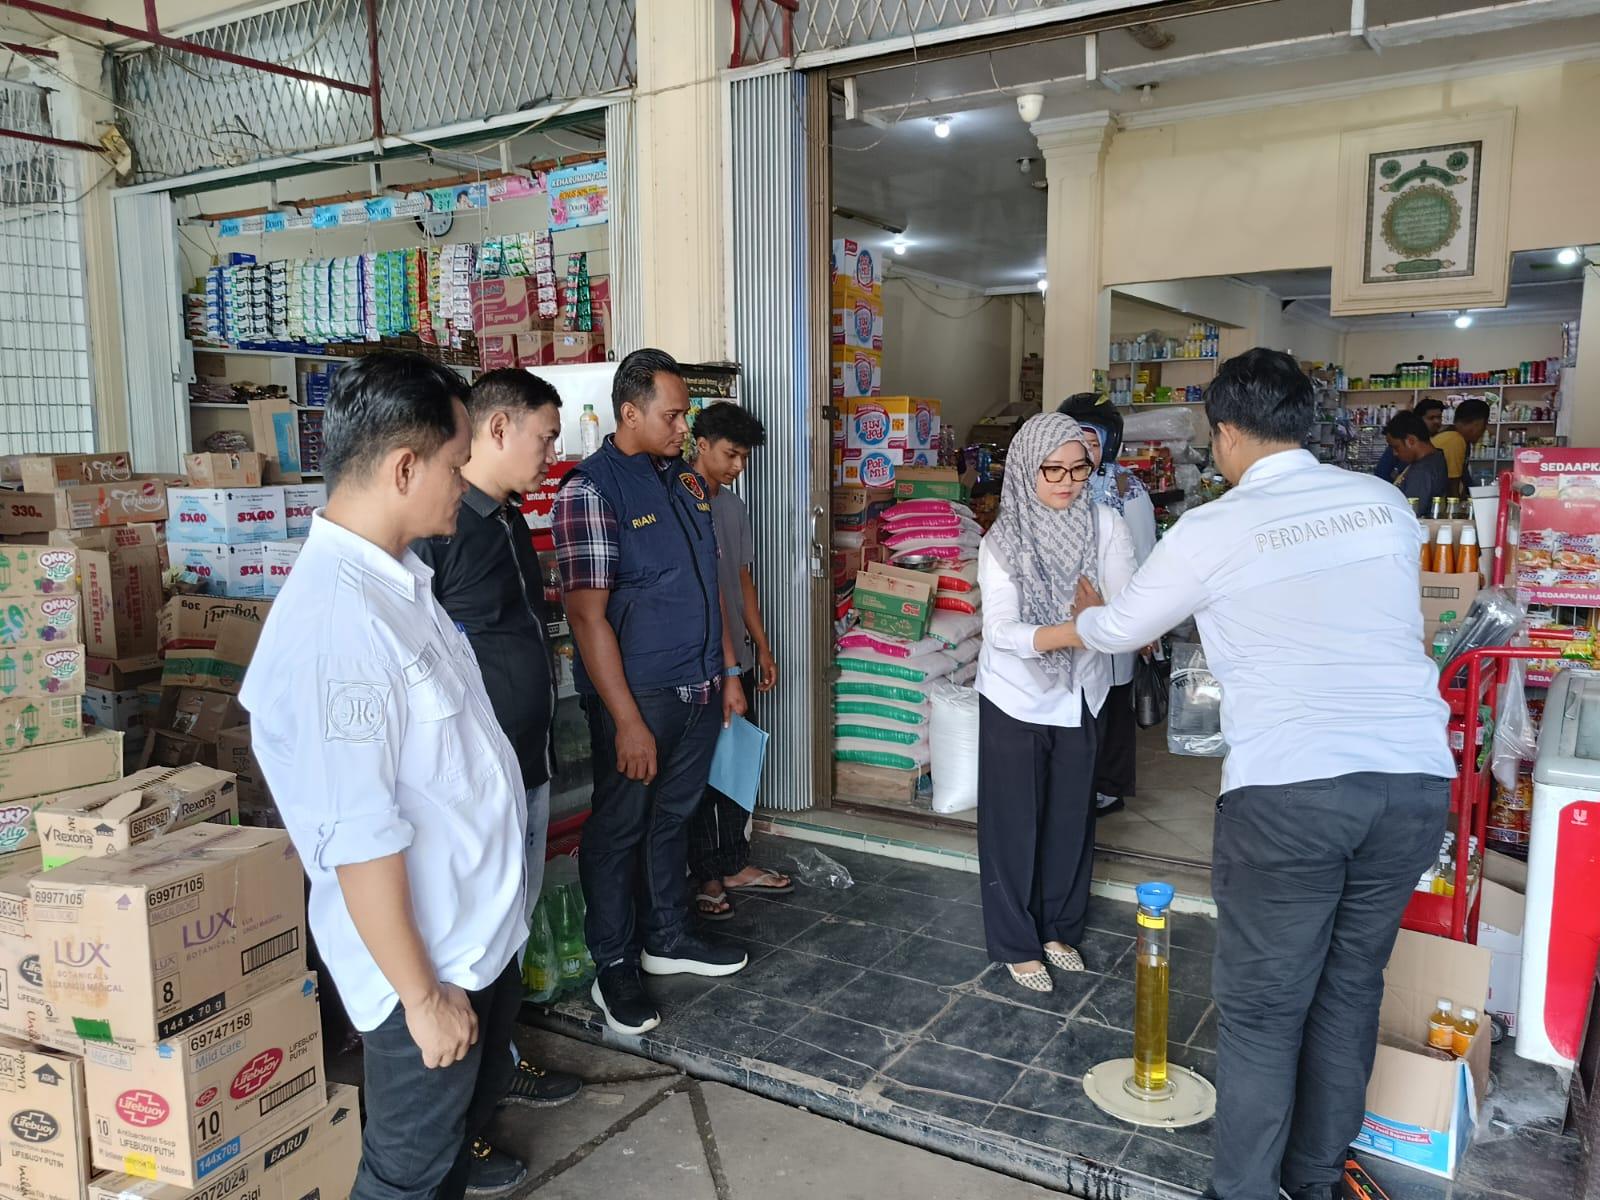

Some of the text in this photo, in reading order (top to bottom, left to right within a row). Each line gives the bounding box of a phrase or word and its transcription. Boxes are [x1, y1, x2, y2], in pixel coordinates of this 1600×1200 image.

[1540, 462, 1600, 472] SEDAAPK
[631, 513, 657, 529] RIAN
[1254, 505, 1394, 553] PERDAGANGAN
[40, 551, 75, 567] OKKY
[41, 598, 76, 614] OKKY
[181, 601, 260, 629] Yogrt! 30g
[45, 650, 80, 666] OKKY
[1528, 674, 1552, 682] SEDA
[181, 794, 217, 815] Rexona
[53, 829, 93, 845] Rexona
[35, 890, 83, 905] 69977105
[149, 877, 204, 906] 69977105
[182, 907, 237, 949] LUX
[54, 940, 111, 968] LUX
[163, 981, 174, 1003] 8
[164, 1016, 184, 1035] 144
[199, 1003, 211, 1016] 70
[190, 1012, 251, 1051] 69747158
[234, 1058, 280, 1089] Lifebuoy
[119, 1098, 165, 1119] Lifebuoy
[14, 1116, 55, 1136] Lifebuoy
[197, 1110, 221, 1141] 10
[199, 1142, 239, 1172] 144x70g
[270, 1133, 303, 1162] BARU
[194, 1167, 246, 1200] 072024
